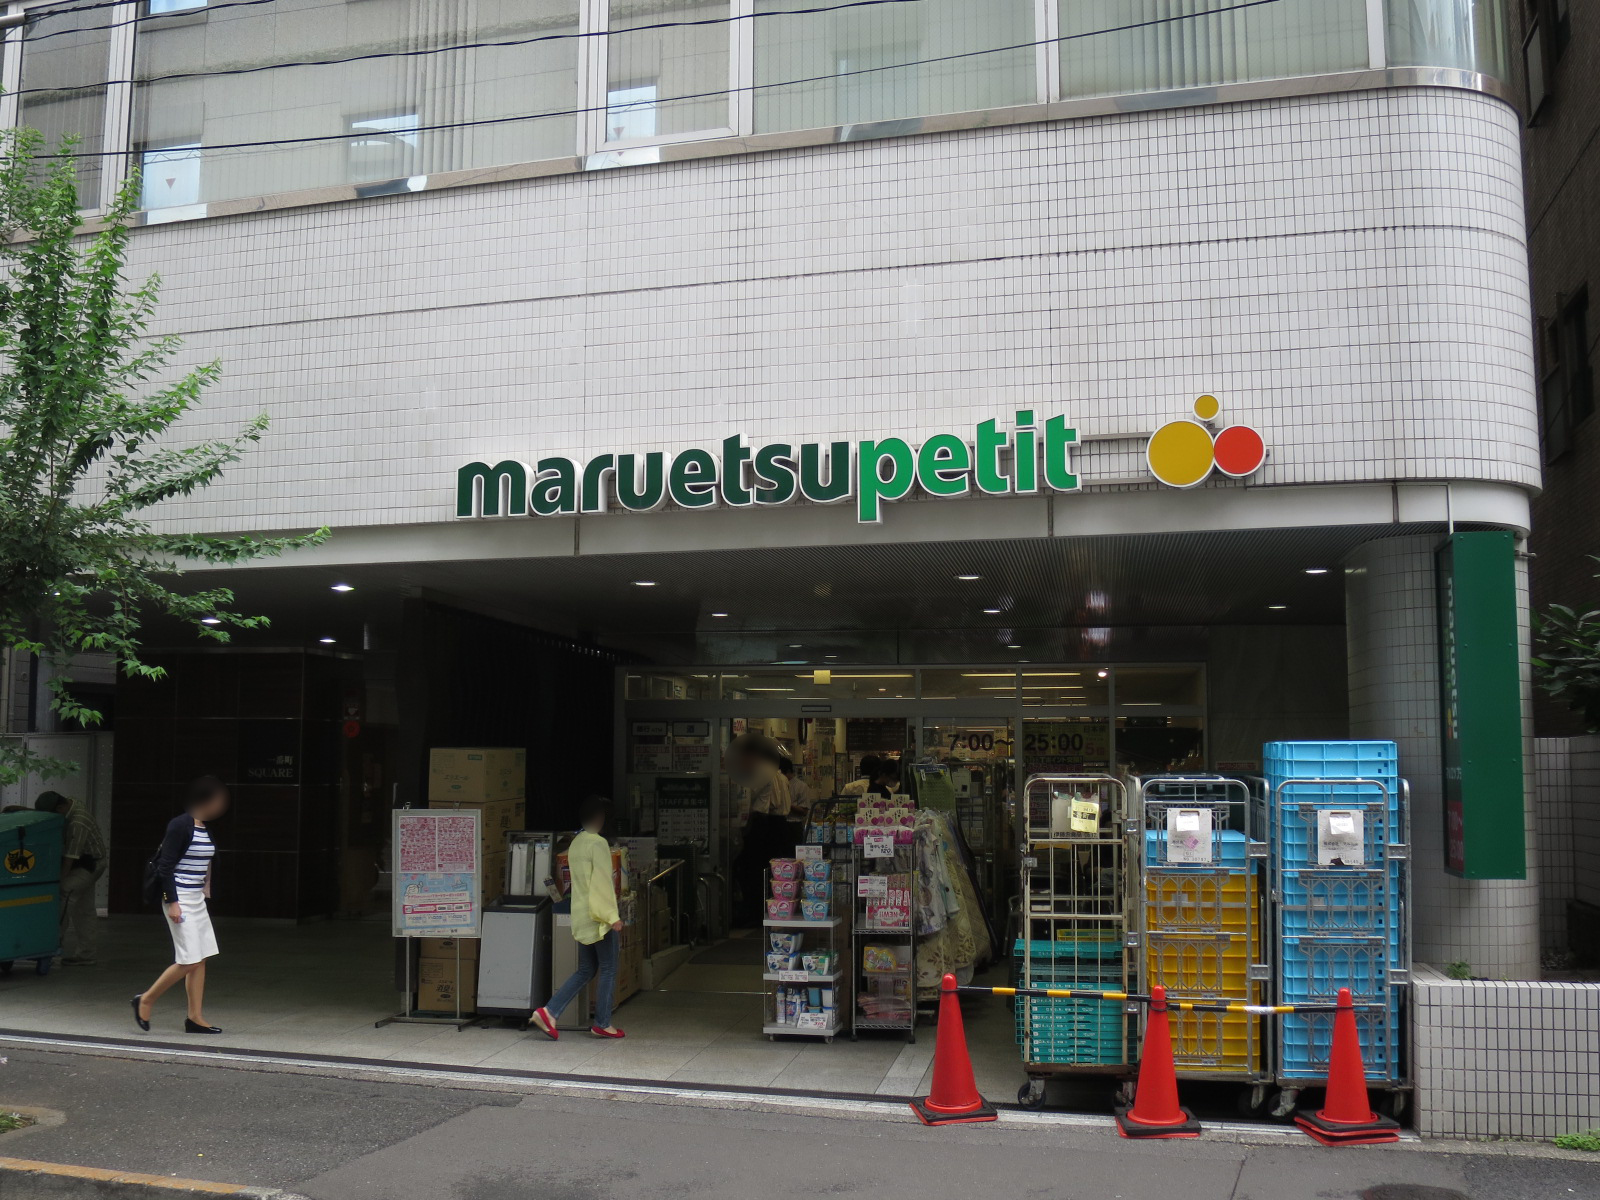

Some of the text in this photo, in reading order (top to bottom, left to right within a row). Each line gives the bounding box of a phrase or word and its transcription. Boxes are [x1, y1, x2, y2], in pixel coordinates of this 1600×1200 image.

[1023, 733, 1084, 752] 25:00
[265, 755, 294, 766] 一番町
[247, 768, 294, 778] SQUARE
